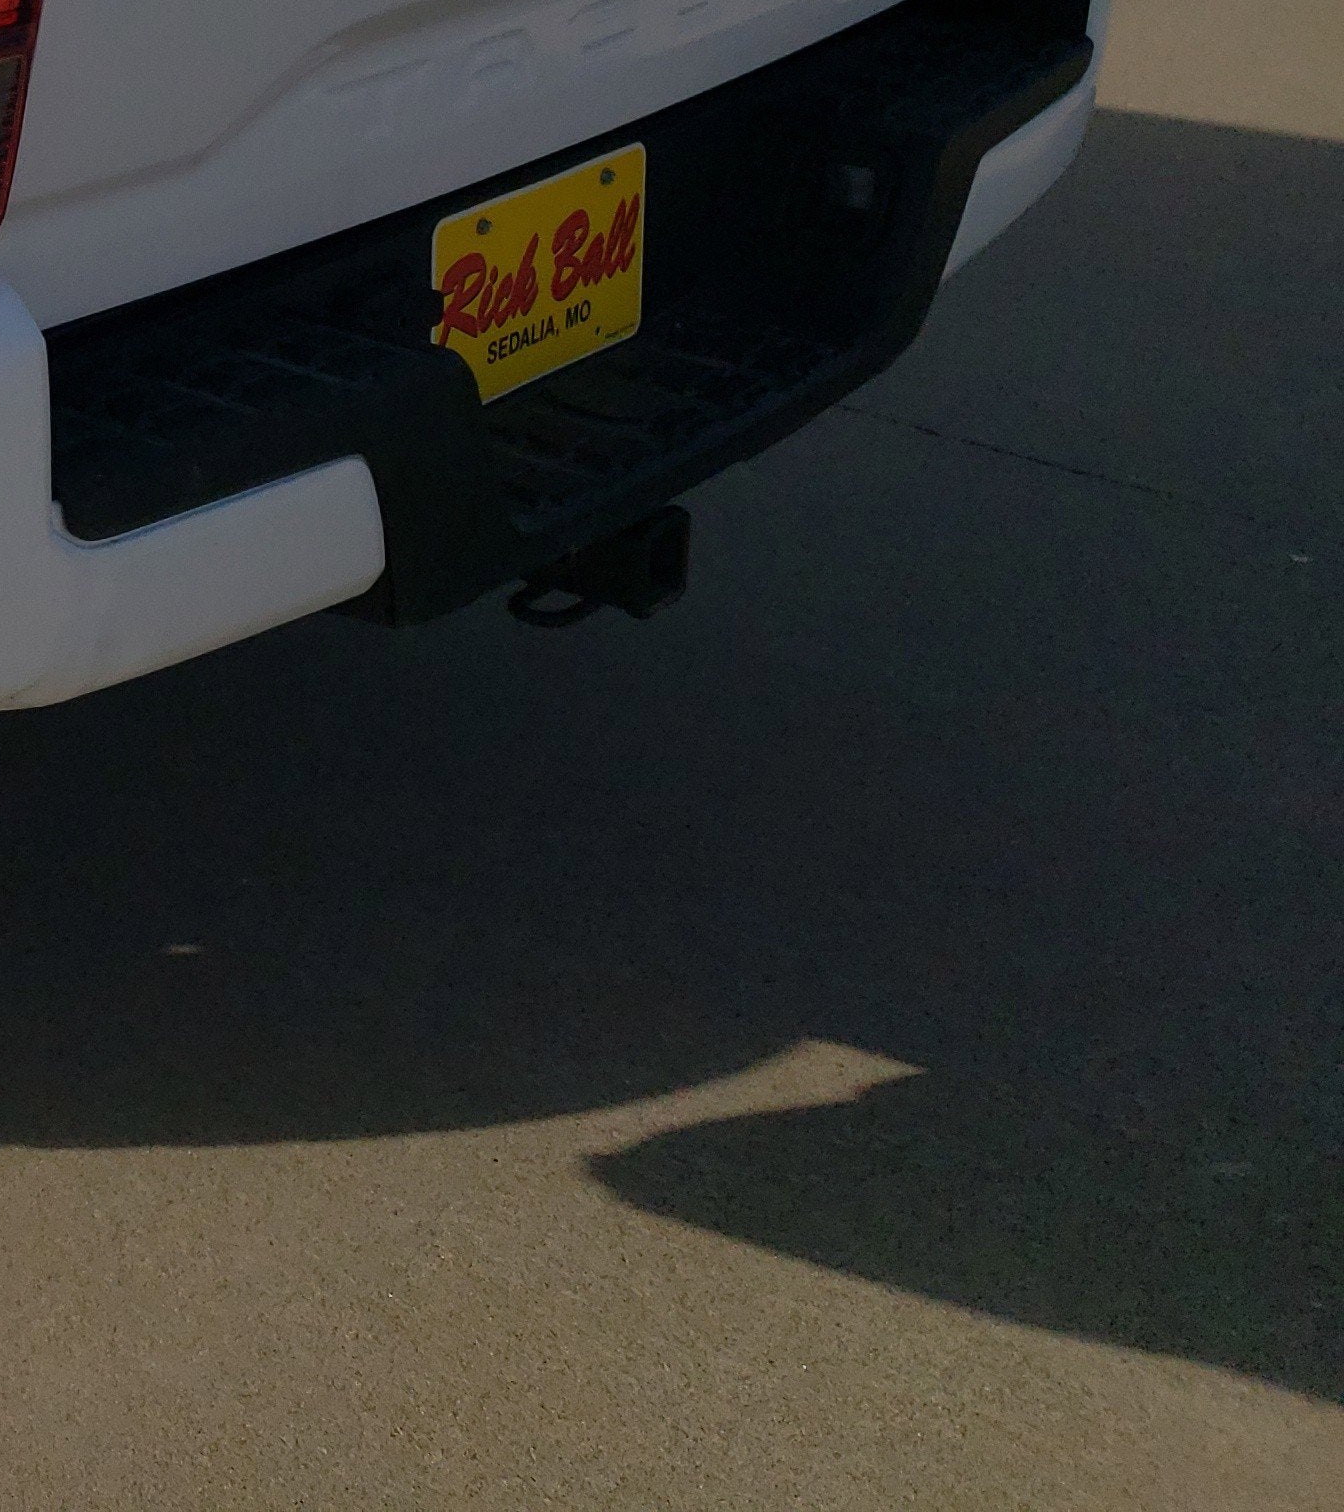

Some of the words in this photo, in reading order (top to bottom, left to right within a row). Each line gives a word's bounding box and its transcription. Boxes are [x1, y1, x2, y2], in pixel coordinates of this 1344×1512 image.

[439, 232, 540, 347] Rick
[551, 192, 640, 301] Ball
[486, 315, 559, 364] SEDALIA,
[565, 300, 591, 329] MO
